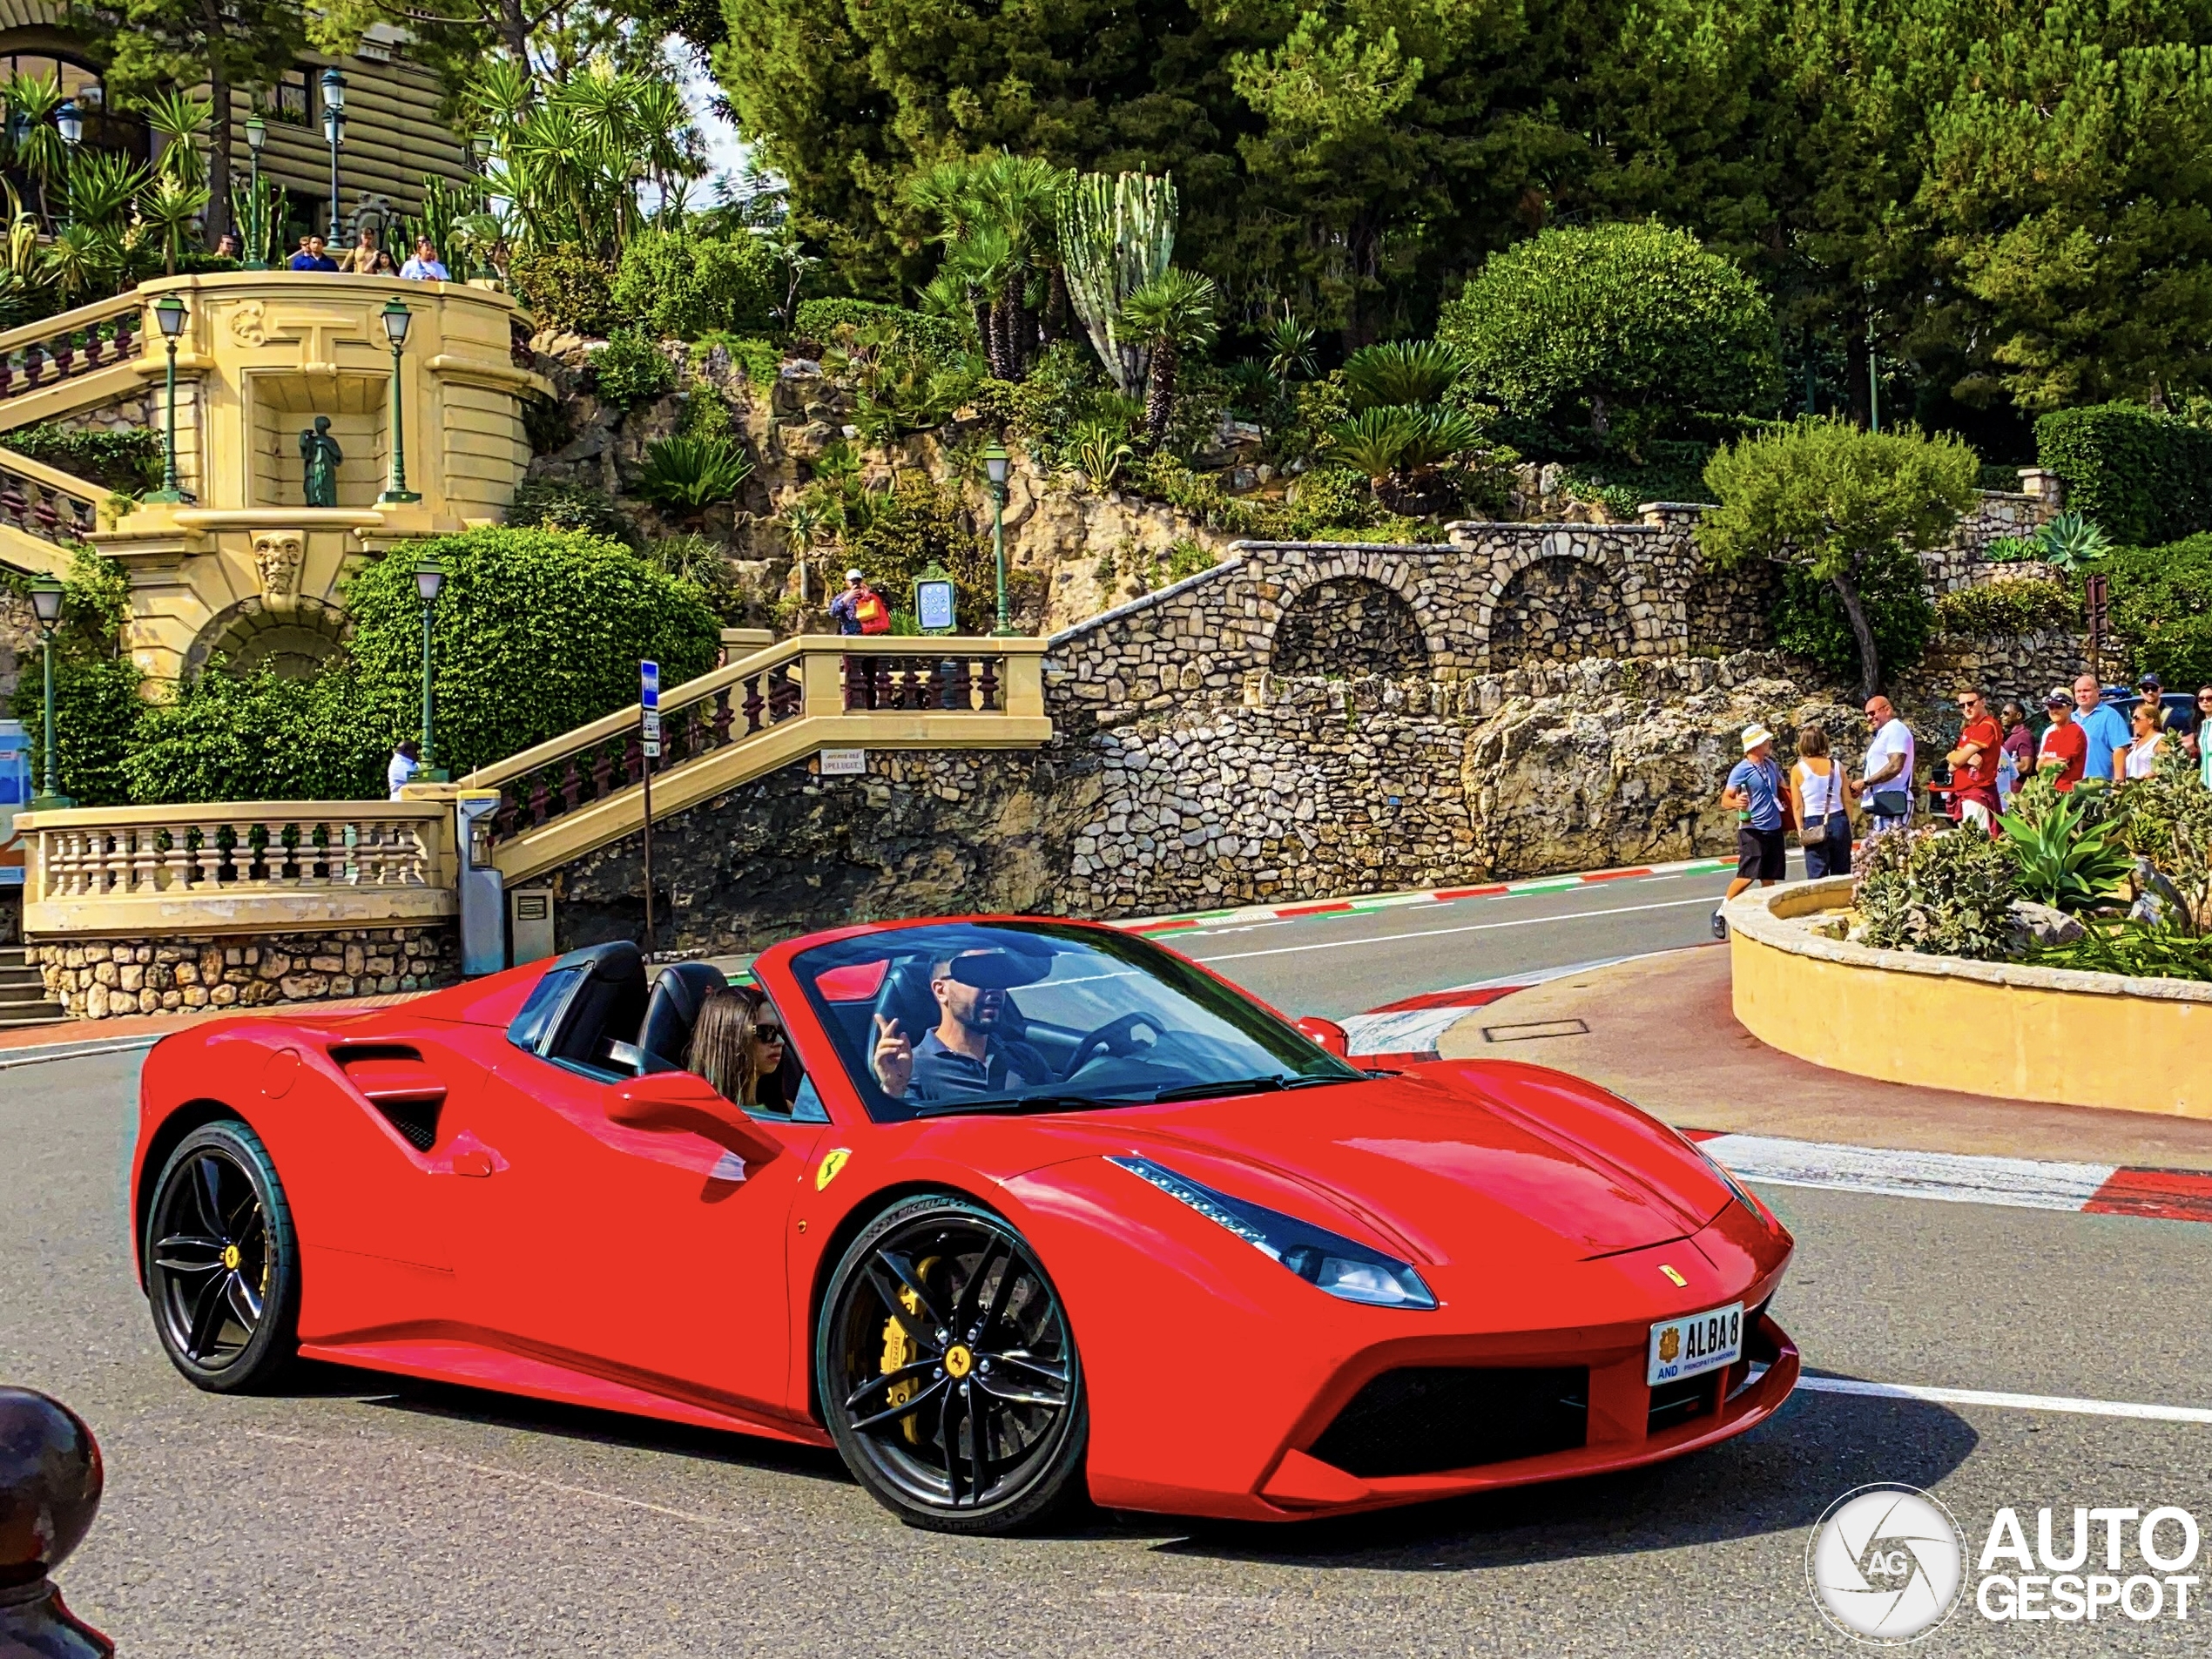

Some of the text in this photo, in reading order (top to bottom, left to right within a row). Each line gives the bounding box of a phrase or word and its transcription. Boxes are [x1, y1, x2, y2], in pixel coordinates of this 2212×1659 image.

[898, 1198, 950, 1217] MICHELIN
[1686, 1312, 1739, 1359] ALBA 8
[1657, 1365, 1678, 1380] AND
